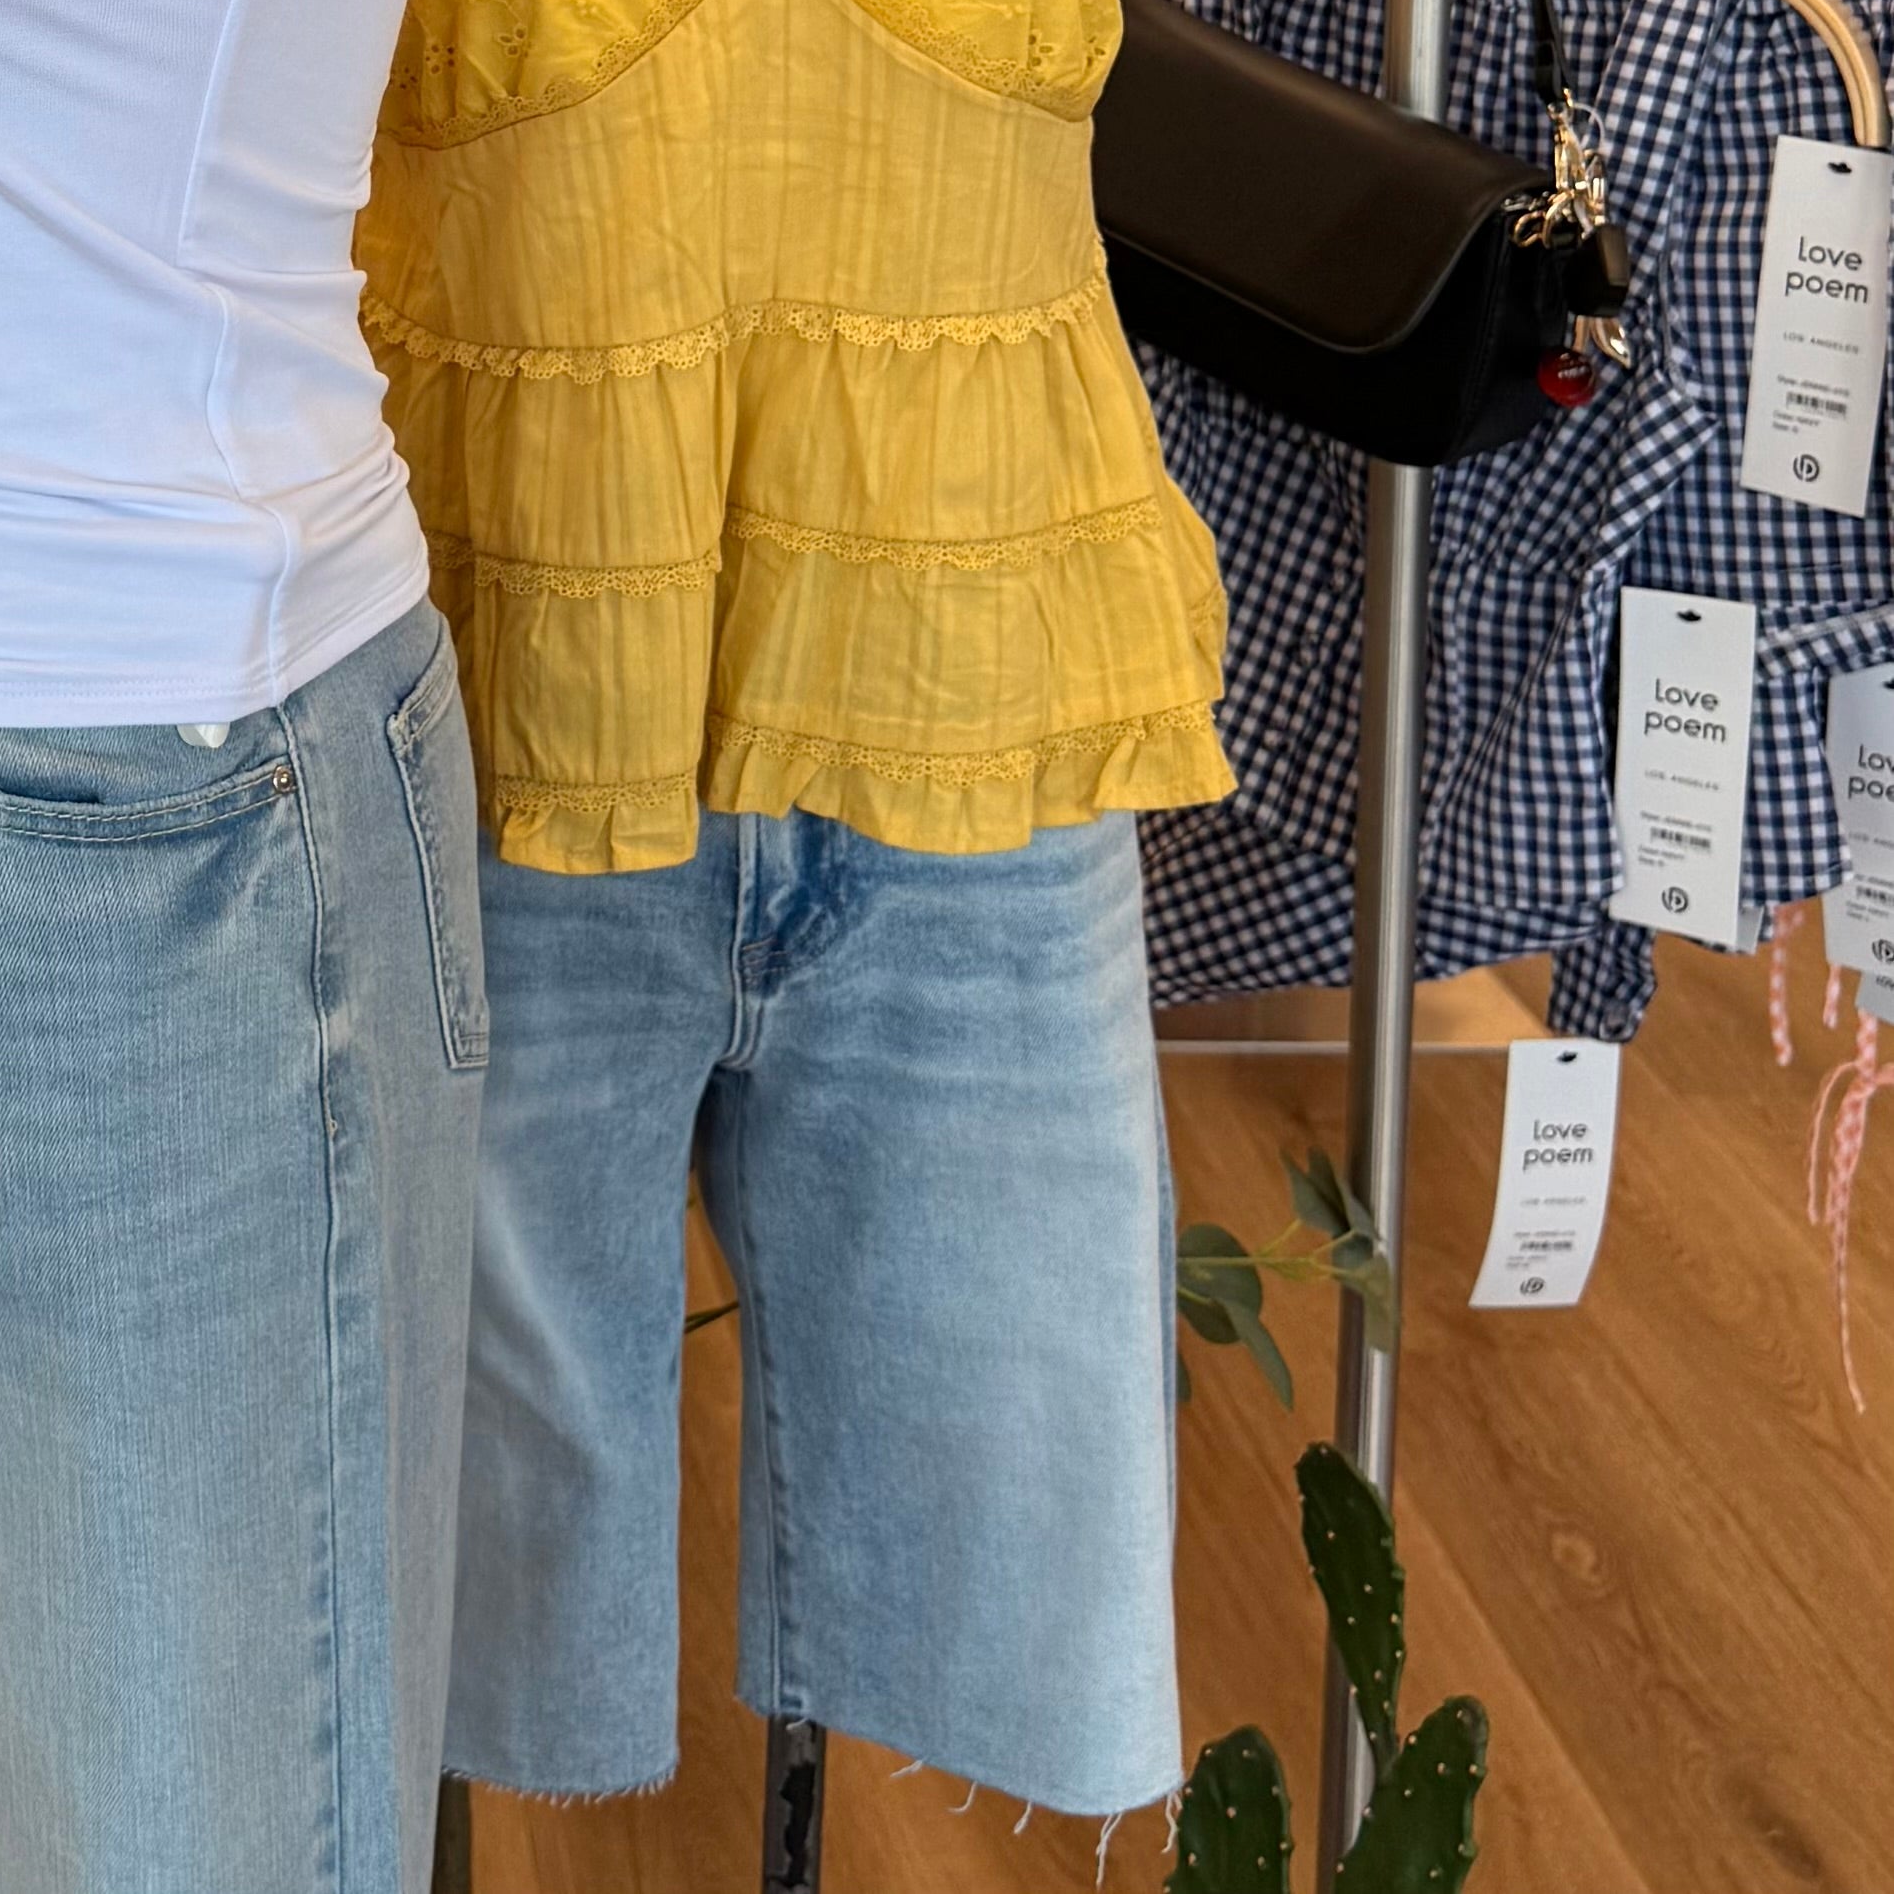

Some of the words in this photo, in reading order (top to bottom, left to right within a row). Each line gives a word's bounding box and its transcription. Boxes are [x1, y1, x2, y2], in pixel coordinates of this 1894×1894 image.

[1785, 271, 1869, 304] poem
[1643, 710, 1727, 743] poem
[1522, 1147, 1593, 1172] poem
